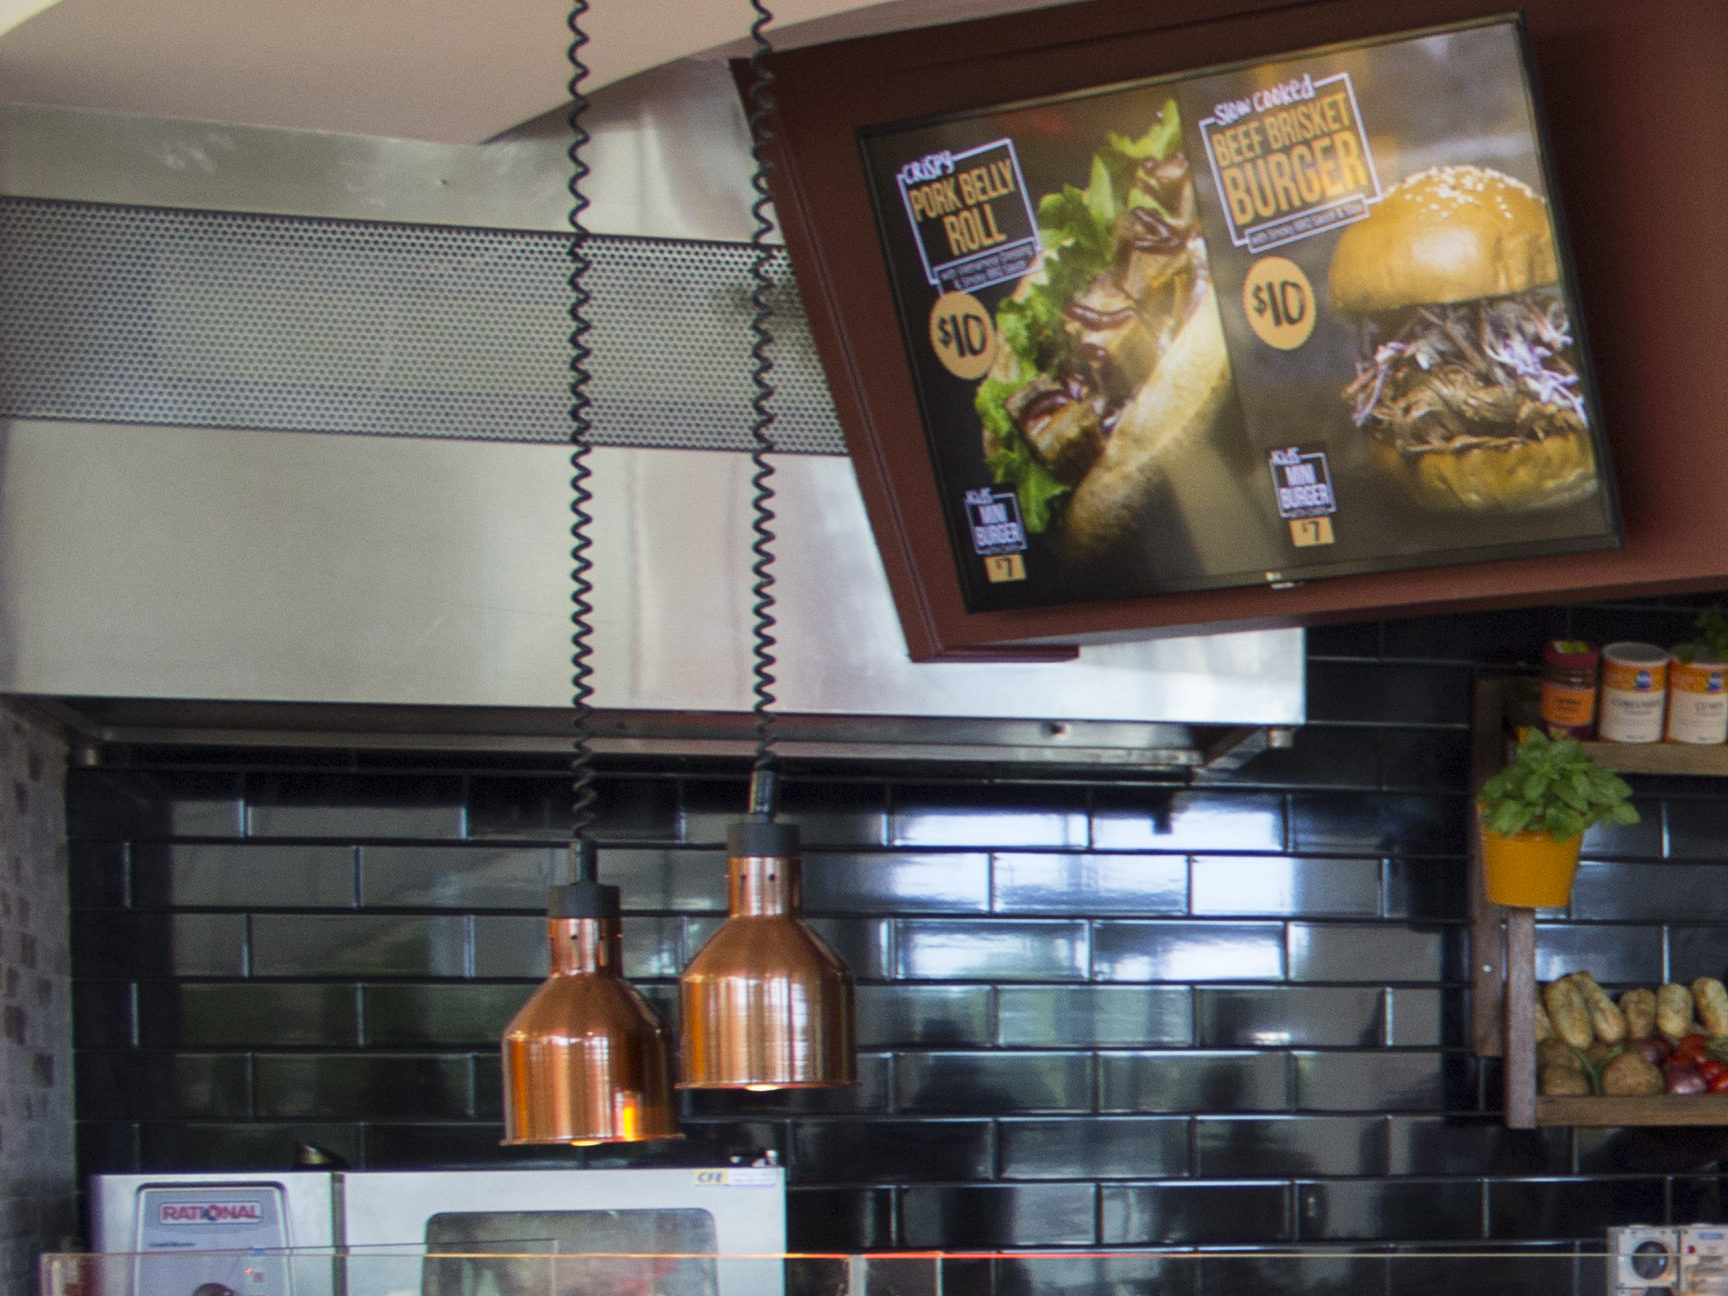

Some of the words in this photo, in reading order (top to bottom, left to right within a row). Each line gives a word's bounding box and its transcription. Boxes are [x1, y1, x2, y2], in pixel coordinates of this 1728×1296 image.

[1211, 121, 1263, 168] BEEF
[1264, 92, 1351, 149] BRISKET
[909, 177, 962, 222] PORK
[958, 159, 1015, 205] BELLY
[1222, 130, 1368, 226] BURGER
[943, 203, 1007, 256] ROLL
[1252, 280, 1304, 327] $10
[938, 313, 987, 357] $10
